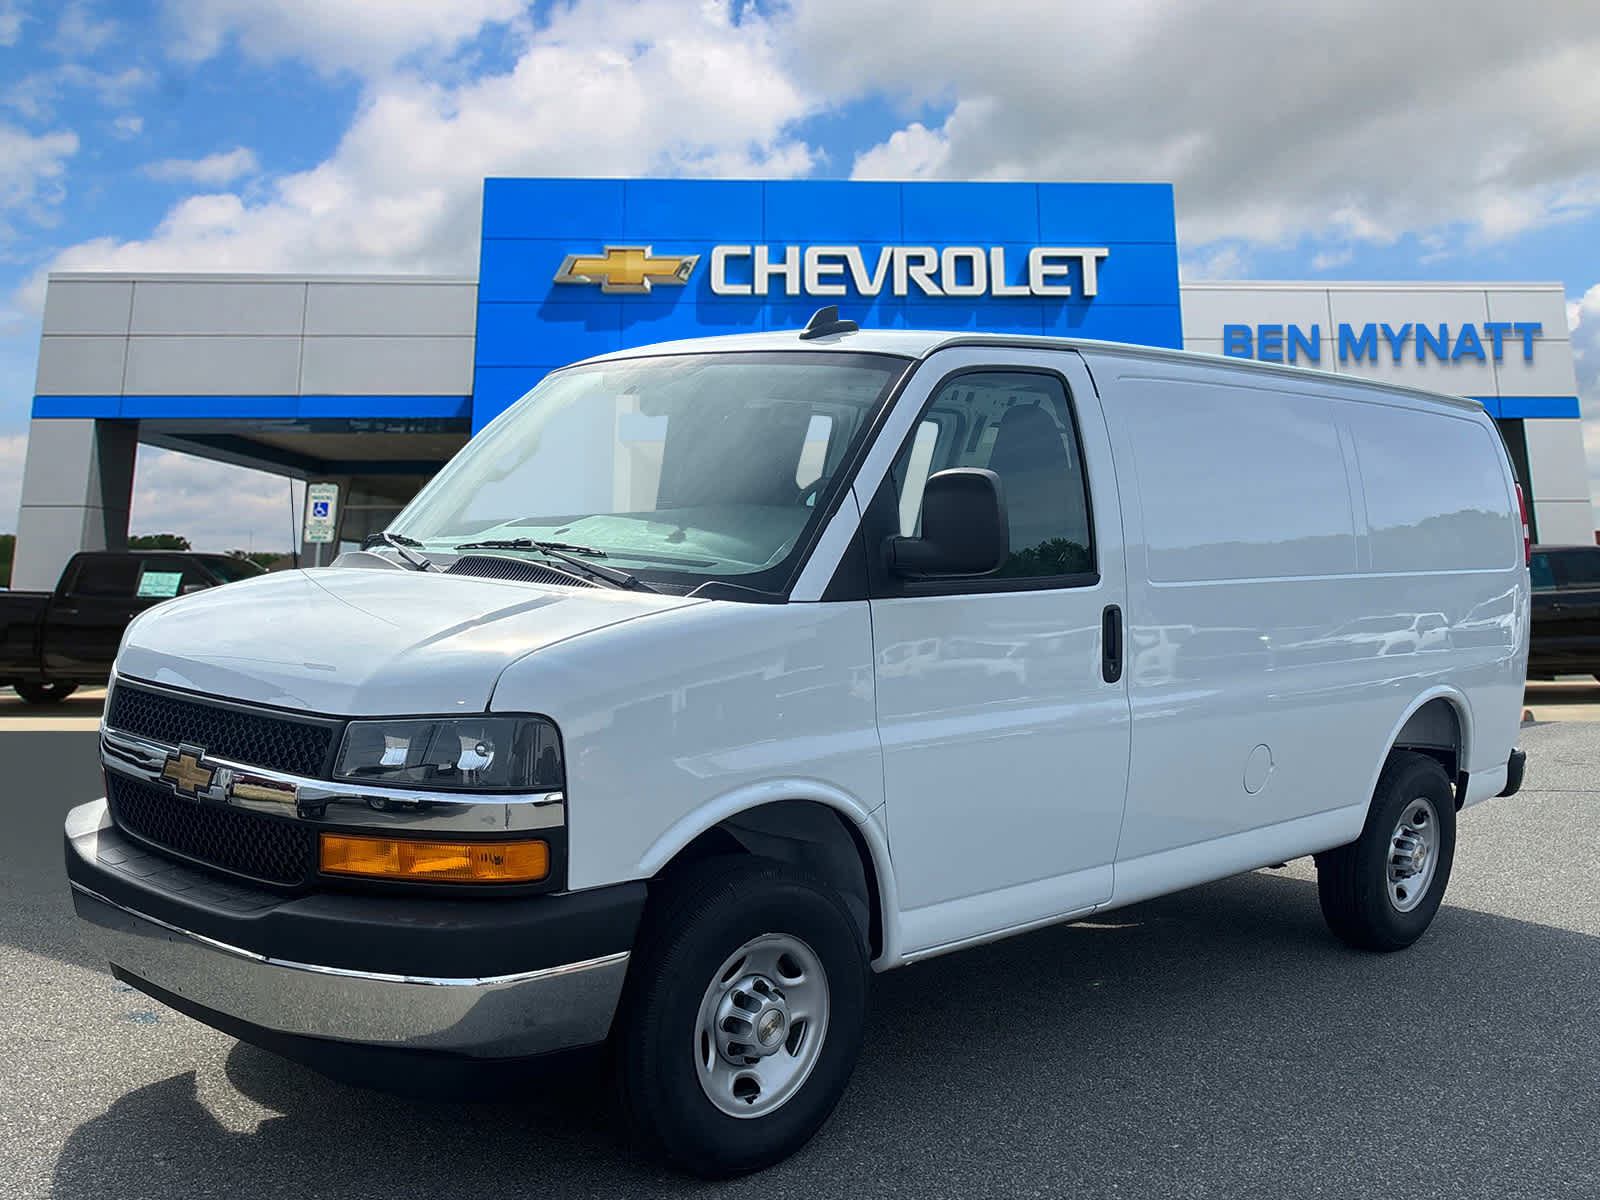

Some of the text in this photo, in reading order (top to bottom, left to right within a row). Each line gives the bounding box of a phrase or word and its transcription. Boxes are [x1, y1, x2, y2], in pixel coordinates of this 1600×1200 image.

[710, 246, 1109, 297] CHEVROLET
[1223, 321, 1543, 363] BEN MYNATT
